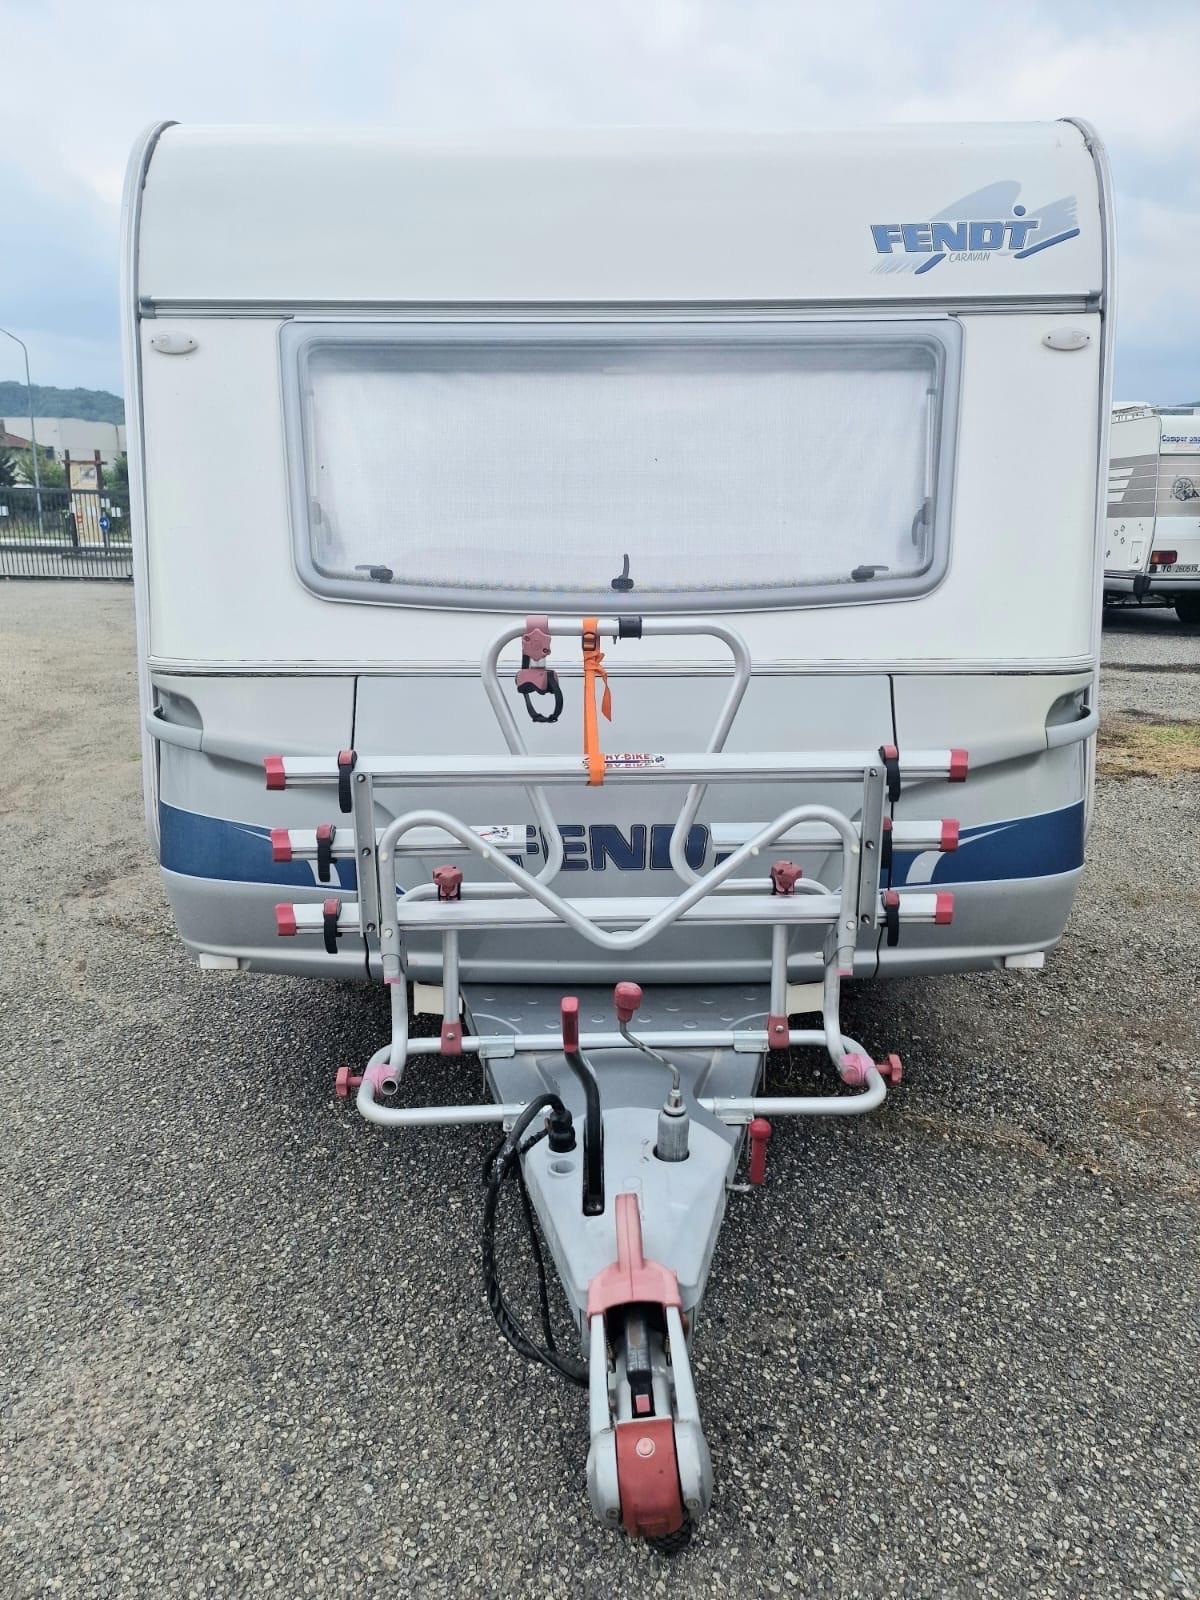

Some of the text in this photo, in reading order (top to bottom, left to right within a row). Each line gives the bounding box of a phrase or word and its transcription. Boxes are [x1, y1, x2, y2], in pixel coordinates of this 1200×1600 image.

[870, 220, 1040, 254] FENDT
[949, 251, 990, 263] CARAVAN
[1161, 434, 1187, 443] Camper
